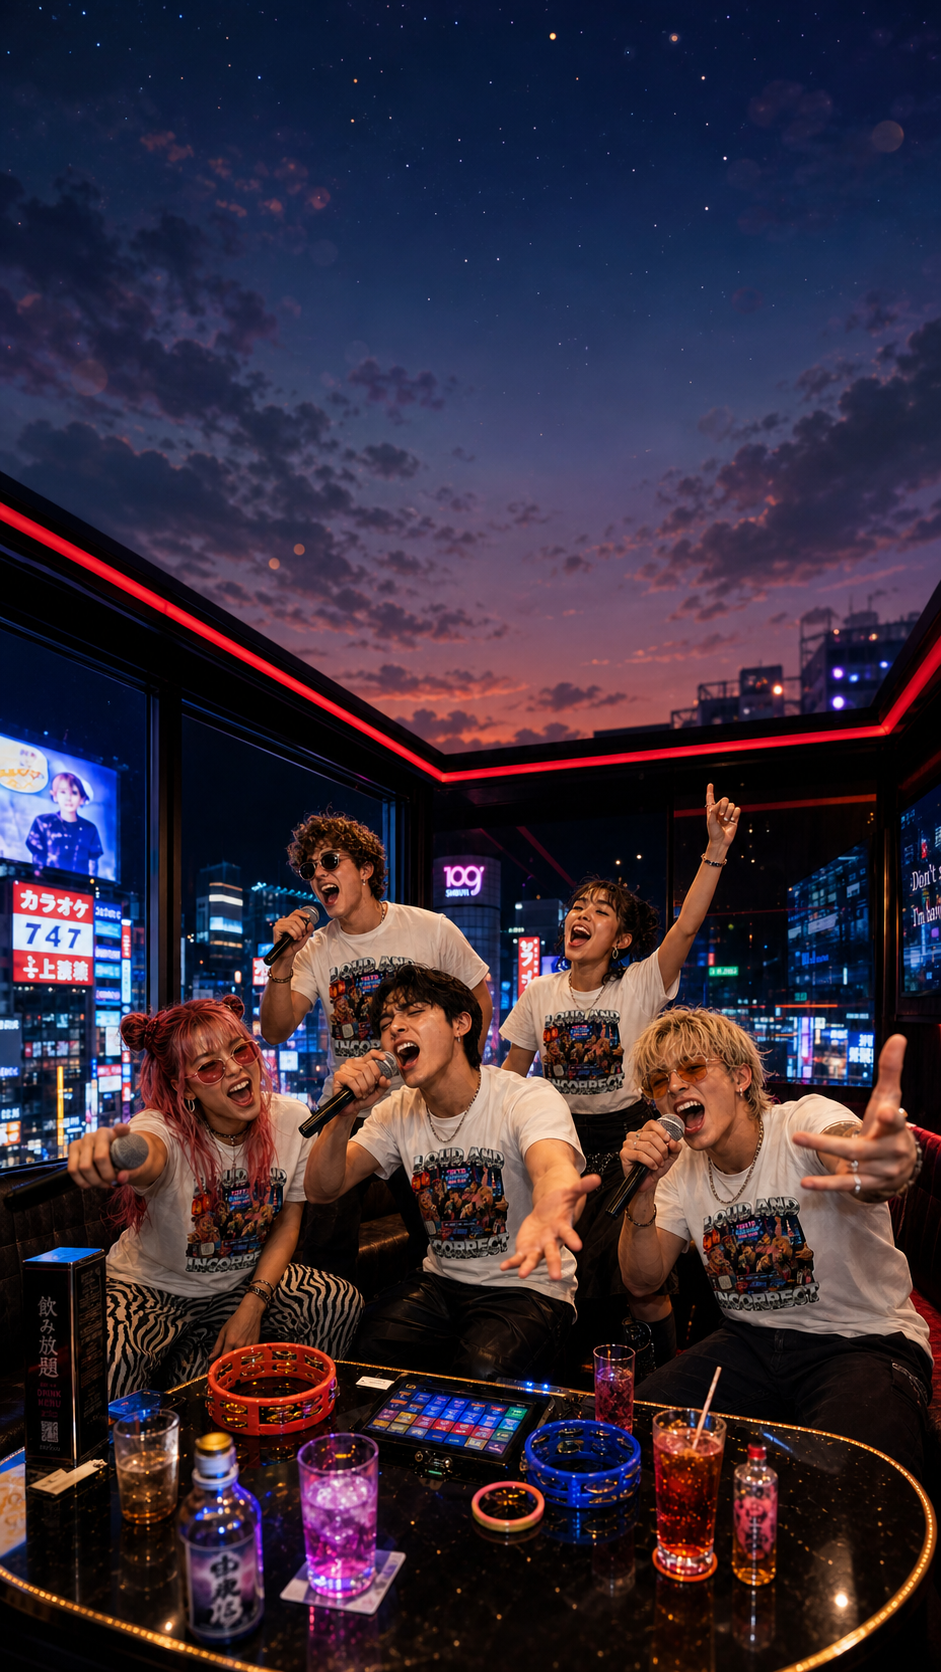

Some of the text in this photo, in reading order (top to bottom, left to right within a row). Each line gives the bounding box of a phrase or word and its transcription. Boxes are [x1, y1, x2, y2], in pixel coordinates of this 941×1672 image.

[20, 890, 89, 918] カラオケ
[25, 922, 81, 949] 747
[329, 957, 376, 984] LOUD
[545, 1009, 620, 1028] LOUD AND
[549, 1074, 625, 1095] NCORRECT
[413, 1146, 505, 1175] LOUD AND
[703, 1202, 752, 1235] LOUD
[755, 1197, 801, 1217] AND
[38, 1296, 59, 1378] 飲み放題
[37, 1389, 61, 1397] DRINK
[38, 1399, 61, 1408] MENU
